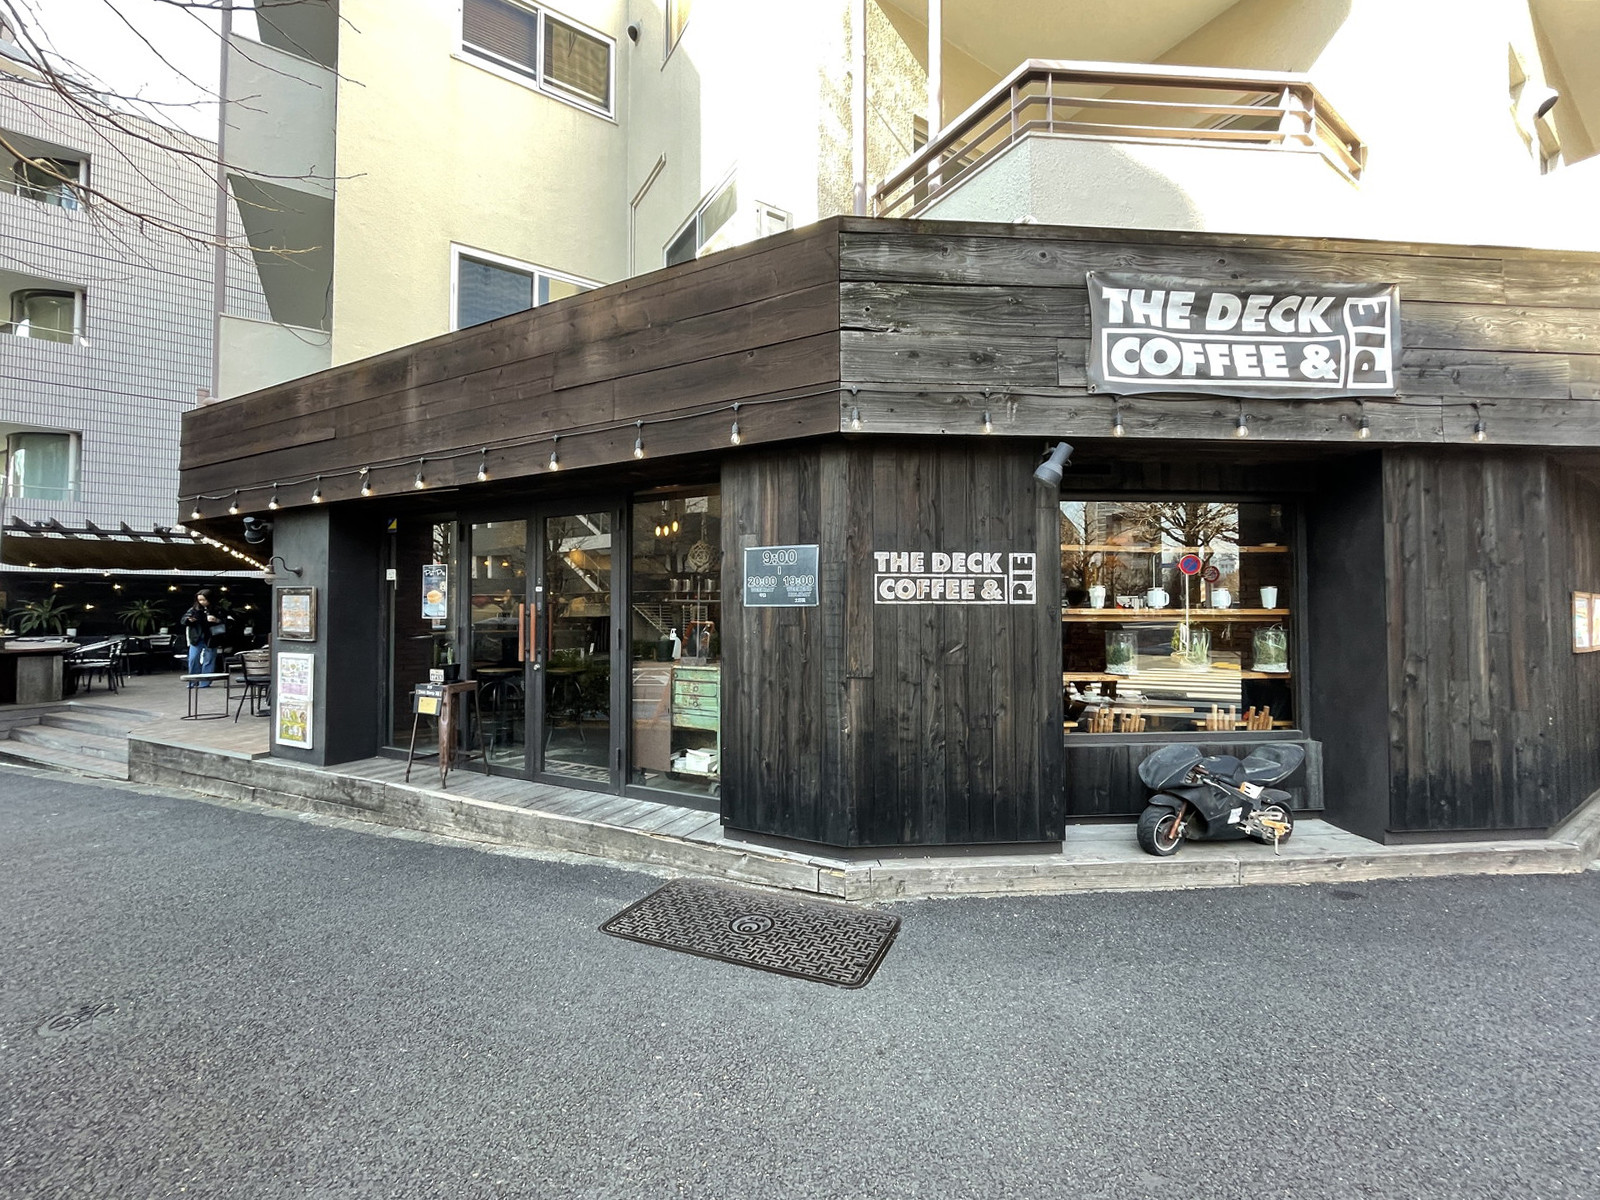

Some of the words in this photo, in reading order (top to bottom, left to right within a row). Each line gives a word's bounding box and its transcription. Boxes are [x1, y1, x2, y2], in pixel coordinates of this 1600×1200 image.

[1101, 286, 1196, 330] THE
[1205, 292, 1336, 333] DECK
[1350, 300, 1387, 383] PIE
[1110, 336, 1290, 378] COFFEE
[1300, 343, 1339, 380] &
[762, 549, 798, 565] 9:00
[873, 551, 925, 573] THE
[931, 552, 1002, 573] DECK
[748, 576, 777, 587] 20:00
[783, 575, 814, 586] 19:00
[879, 578, 975, 600] COFFEE
[980, 579, 1003, 600] &
[1011, 554, 1034, 602] PIE
